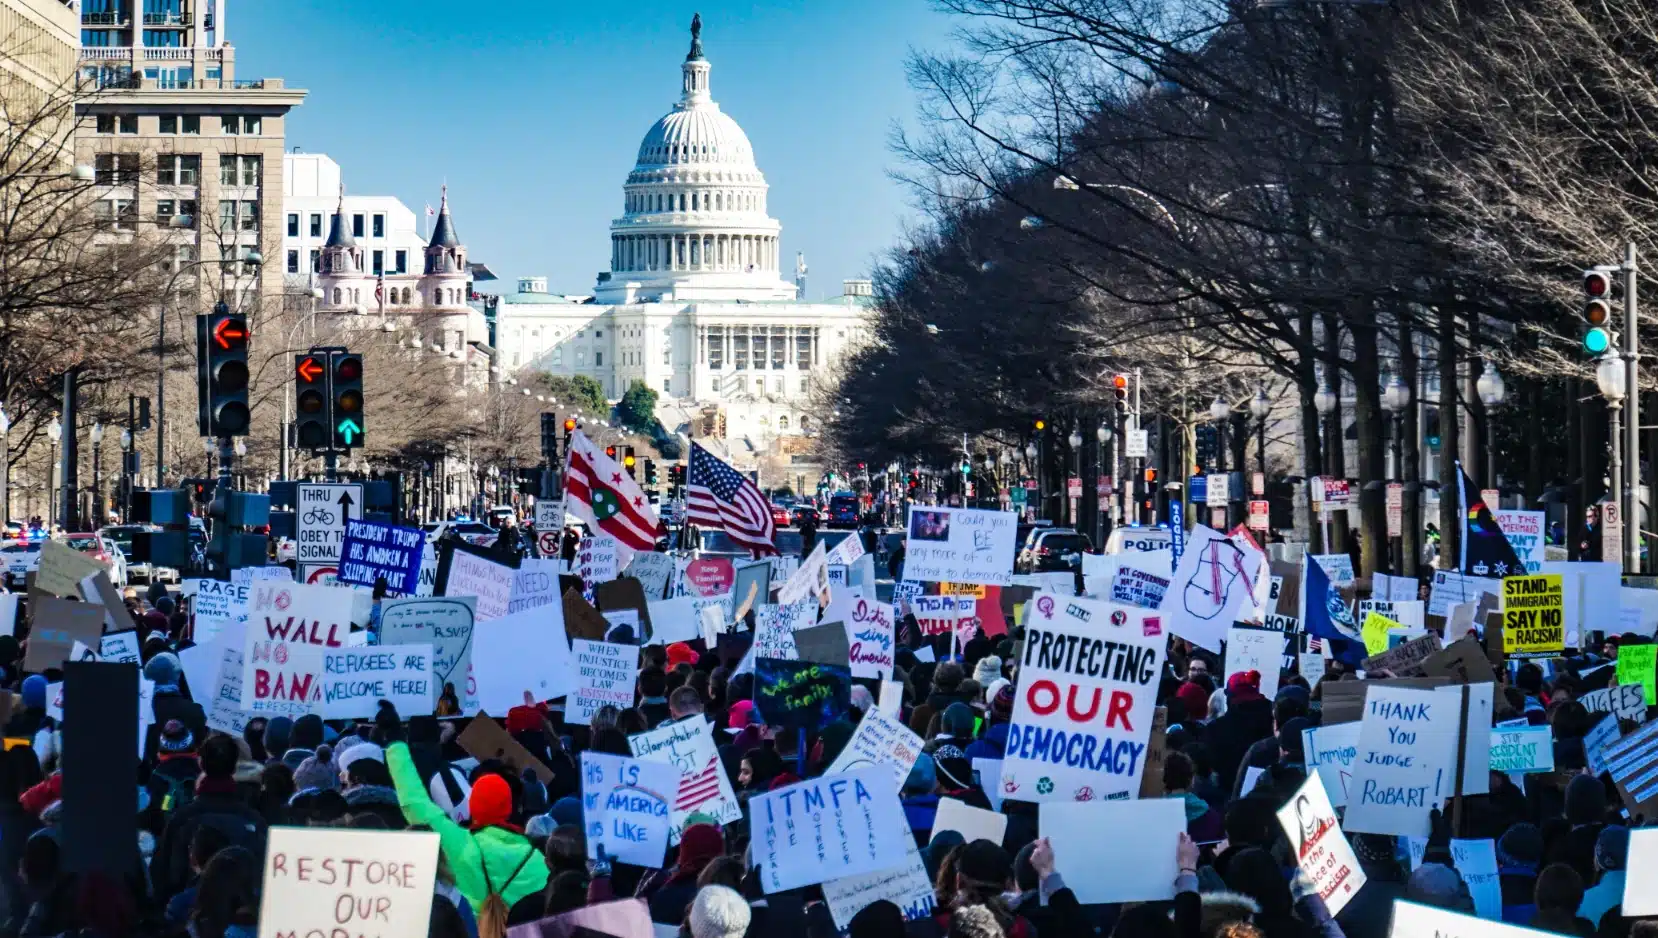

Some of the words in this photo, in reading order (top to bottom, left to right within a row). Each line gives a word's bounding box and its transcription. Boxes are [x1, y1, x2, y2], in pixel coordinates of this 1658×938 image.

[302, 488, 331, 502] THRU
[957, 513, 984, 526] Could
[992, 518, 1008, 530] you
[1518, 515, 1539, 525] THE
[300, 531, 329, 543] OBEY
[334, 531, 345, 543] TH
[348, 522, 388, 542] PRESIDENT
[393, 530, 420, 548] TRUMP
[1503, 523, 1539, 535] MERMAID
[580, 539, 592, 552] NO
[594, 539, 613, 548] HATE
[974, 529, 994, 547] BE
[1125, 540, 1173, 550] POLIC
[300, 546, 339, 559] SIGNAL
[350, 545, 364, 560] HAS
[366, 549, 401, 567] AWOKEN
[402, 554, 409, 567] A
[910, 547, 927, 561] any
[932, 549, 957, 561] more
[964, 552, 978, 563] of
[986, 555, 993, 564] a
[701, 565, 719, 574] Keep
[946, 568, 958, 578] to
[515, 572, 549, 594] NEED
[696, 574, 725, 583] Families
[1506, 578, 1547, 595] STAND
[1548, 585, 1562, 594] with
[199, 579, 250, 600] RAGE
[197, 601, 217, 610] dying
[198, 594, 229, 604] against
[256, 586, 292, 613] NO
[508, 595, 553, 615] OTECTION
[1361, 601, 1373, 610] NO
[1506, 595, 1562, 609] IMMIGRANTS!
[1265, 614, 1300, 634] HOM
[1507, 611, 1537, 630] SAY
[1541, 609, 1561, 627] NO
[264, 616, 342, 648] WALL
[434, 626, 469, 638] RSVP
[1516, 629, 1562, 645] RACISM!
[252, 641, 289, 665] NO
[588, 643, 620, 656] WHEN
[764, 641, 797, 650] MEXICA
[325, 652, 396, 674] REFUGEES
[404, 654, 426, 672] ARE
[578, 653, 631, 671] INJUSTICE
[1025, 628, 1156, 686] PROTECTING
[579, 668, 628, 683] BECOMES
[324, 679, 385, 704] WELCOME
[392, 679, 427, 698] HERE!
[591, 679, 614, 691] LAW
[1026, 679, 1134, 733] OUR
[1583, 683, 1643, 713] UGEES
[1370, 698, 1431, 722] THANK
[632, 726, 701, 758] Islamophobia
[1388, 725, 1417, 746] YOU
[1500, 732, 1523, 744] STOP
[1006, 723, 1145, 778] DEMOCRACY
[1305, 728, 1357, 768] Immigra
[1490, 743, 1537, 758] RESIDENT
[1364, 751, 1413, 768] JUDGE
[272, 852, 417, 890] RESTORE
[1312, 865, 1328, 886] ace
[1326, 851, 1337, 870] of
[1319, 863, 1351, 900] ascism
[335, 893, 392, 925] OUR
